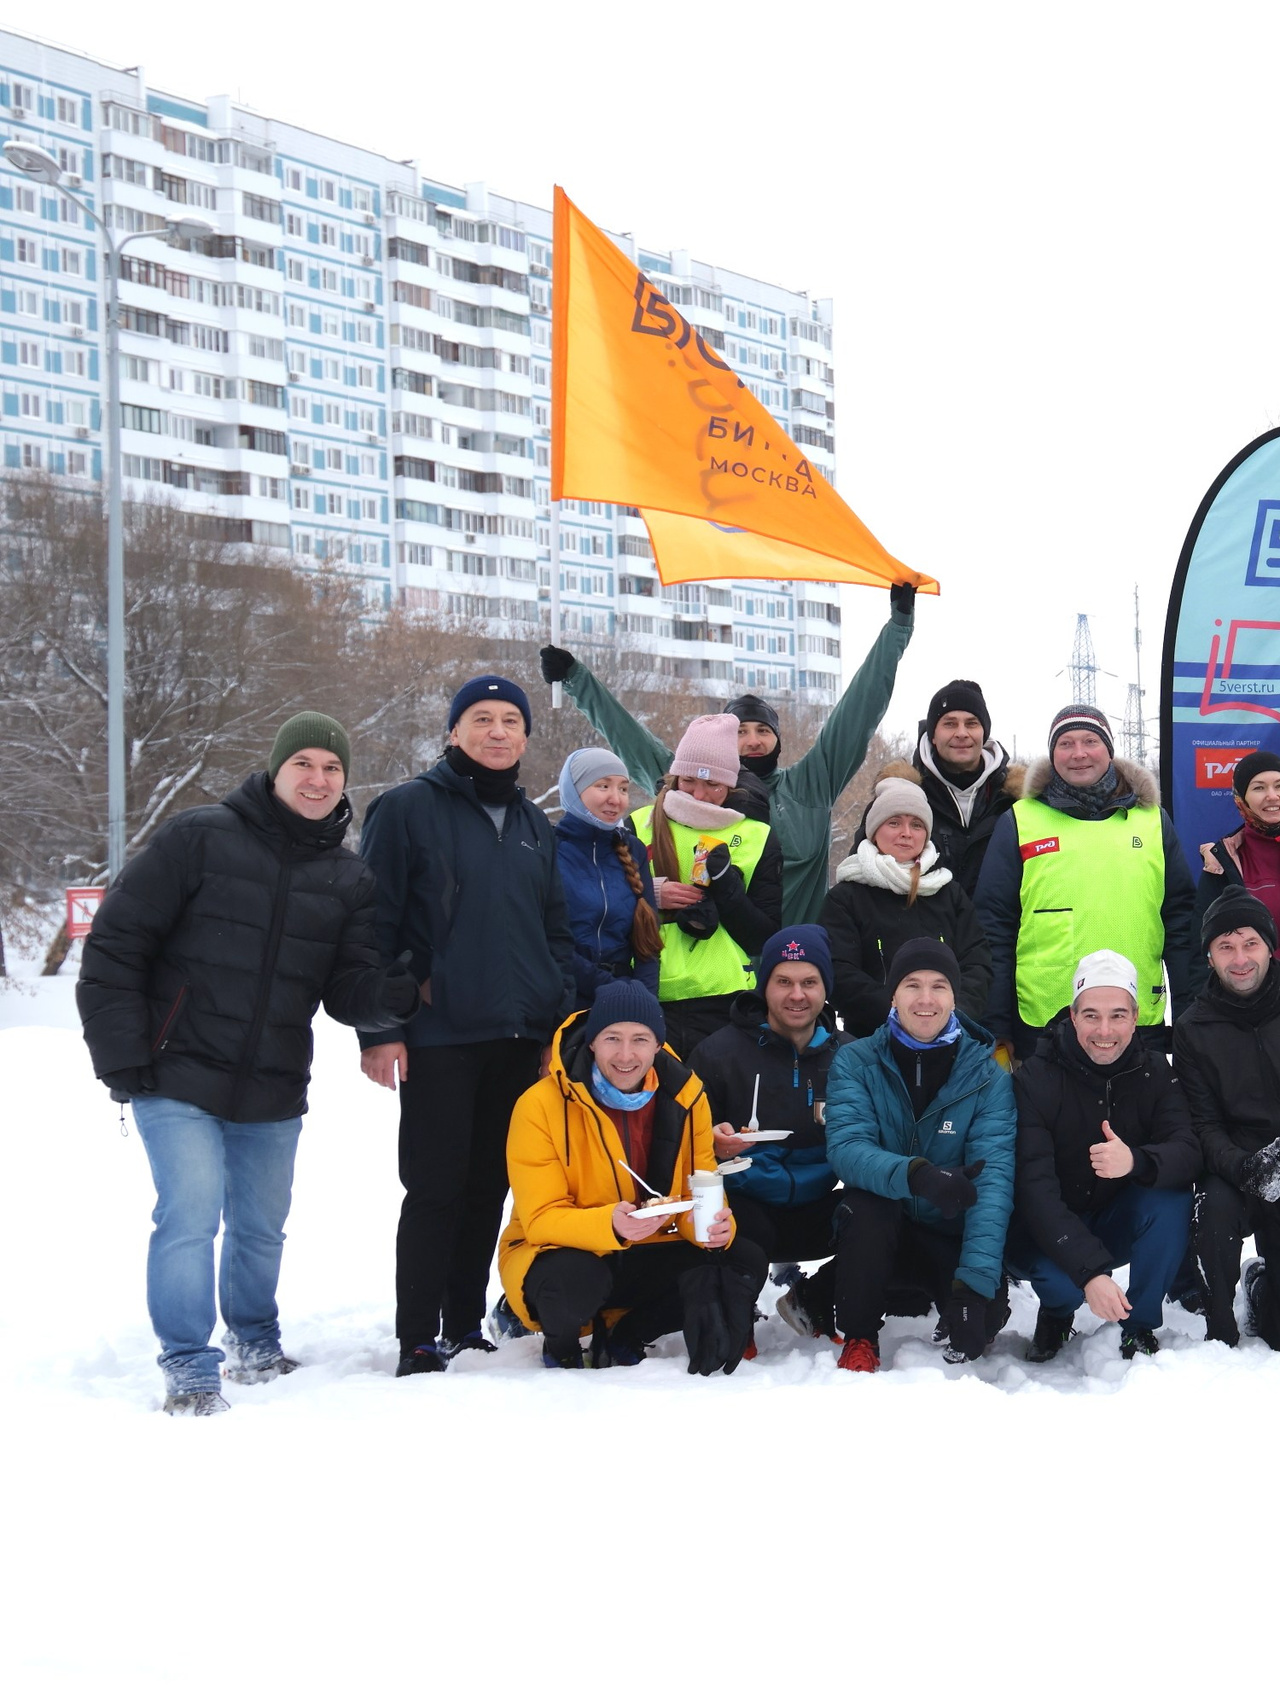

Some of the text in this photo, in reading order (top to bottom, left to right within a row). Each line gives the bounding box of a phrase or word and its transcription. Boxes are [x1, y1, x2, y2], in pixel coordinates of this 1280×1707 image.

[708, 415, 813, 483] БИА
[710, 456, 817, 499] МОСКВА
[1219, 680, 1275, 693] 5verst.ru
